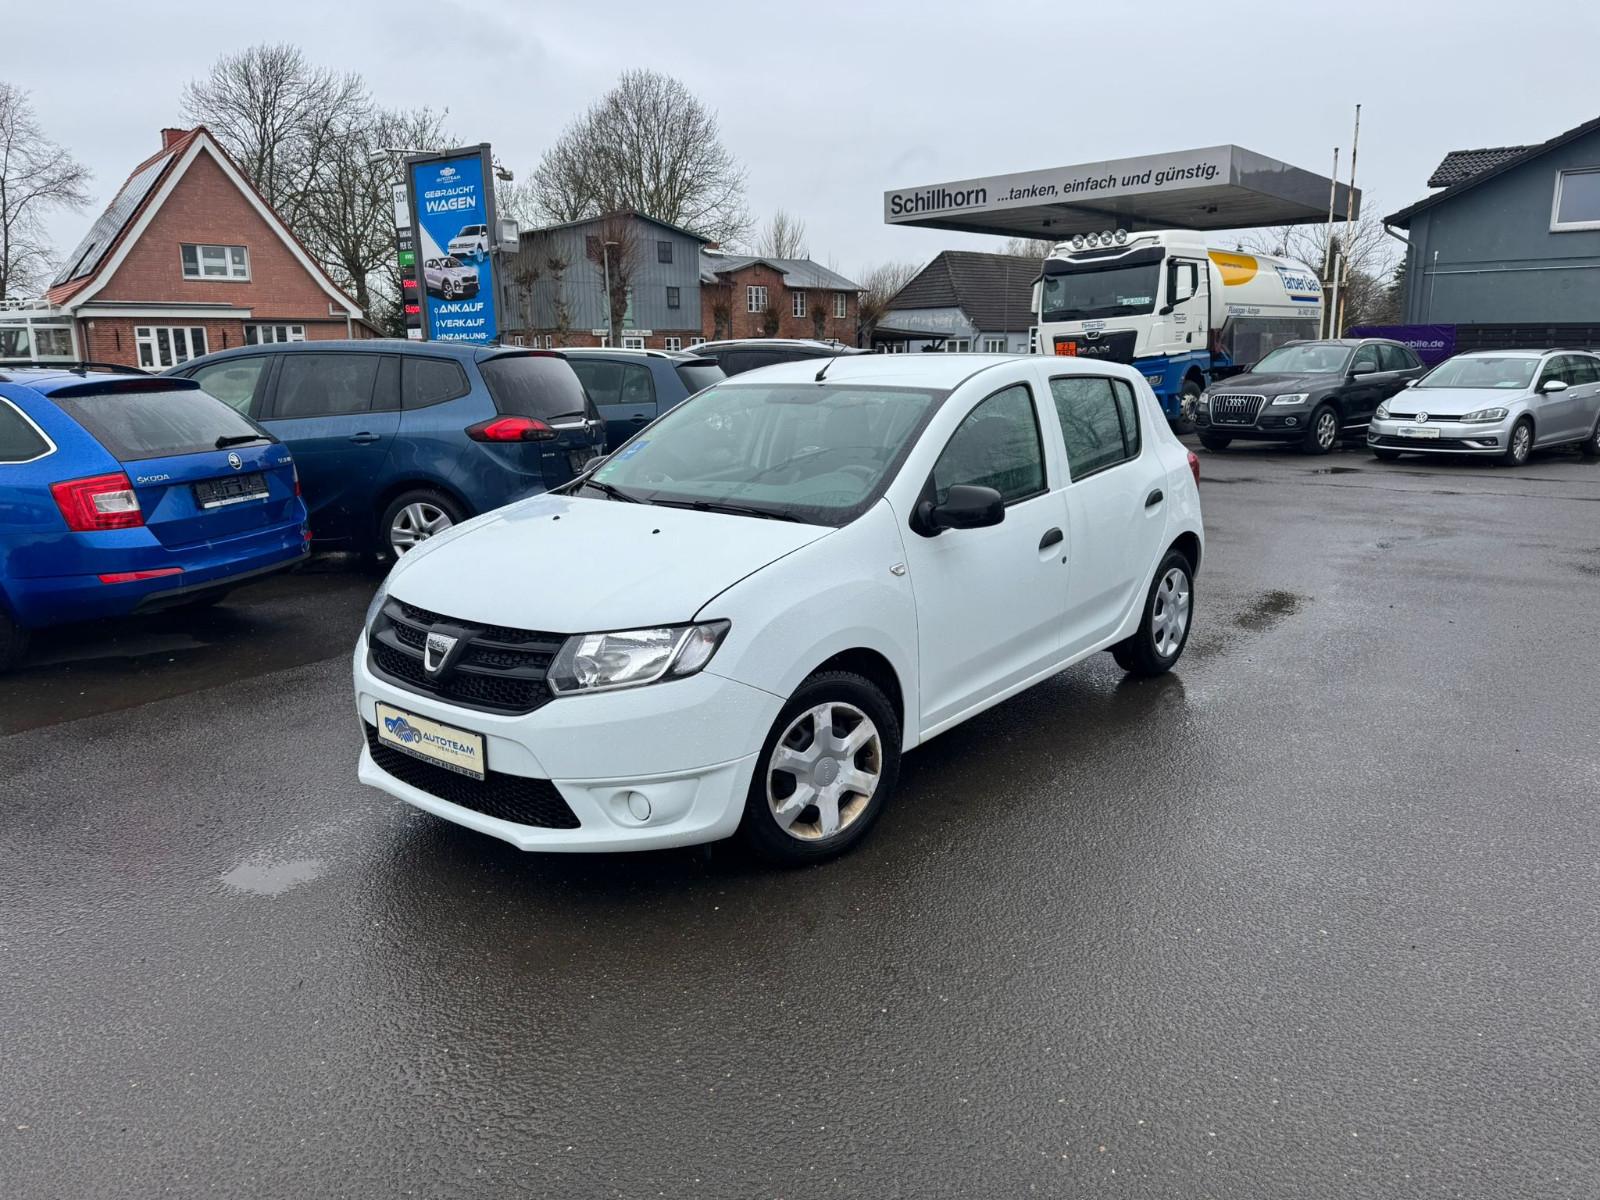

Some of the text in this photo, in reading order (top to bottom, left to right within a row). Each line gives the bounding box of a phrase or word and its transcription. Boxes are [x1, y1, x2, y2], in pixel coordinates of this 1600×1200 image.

[424, 185, 475, 199] GEBRAUCHT
[891, 162, 1220, 215] Schillhorn ...tanken, einfach und günstig.
[426, 195, 476, 213] WAGEN
[439, 302, 484, 313] ANKAUF
[440, 318, 485, 328] VERKAUF
[1077, 345, 1111, 355] MAN
[423, 732, 476, 756] AUTOTEAM
